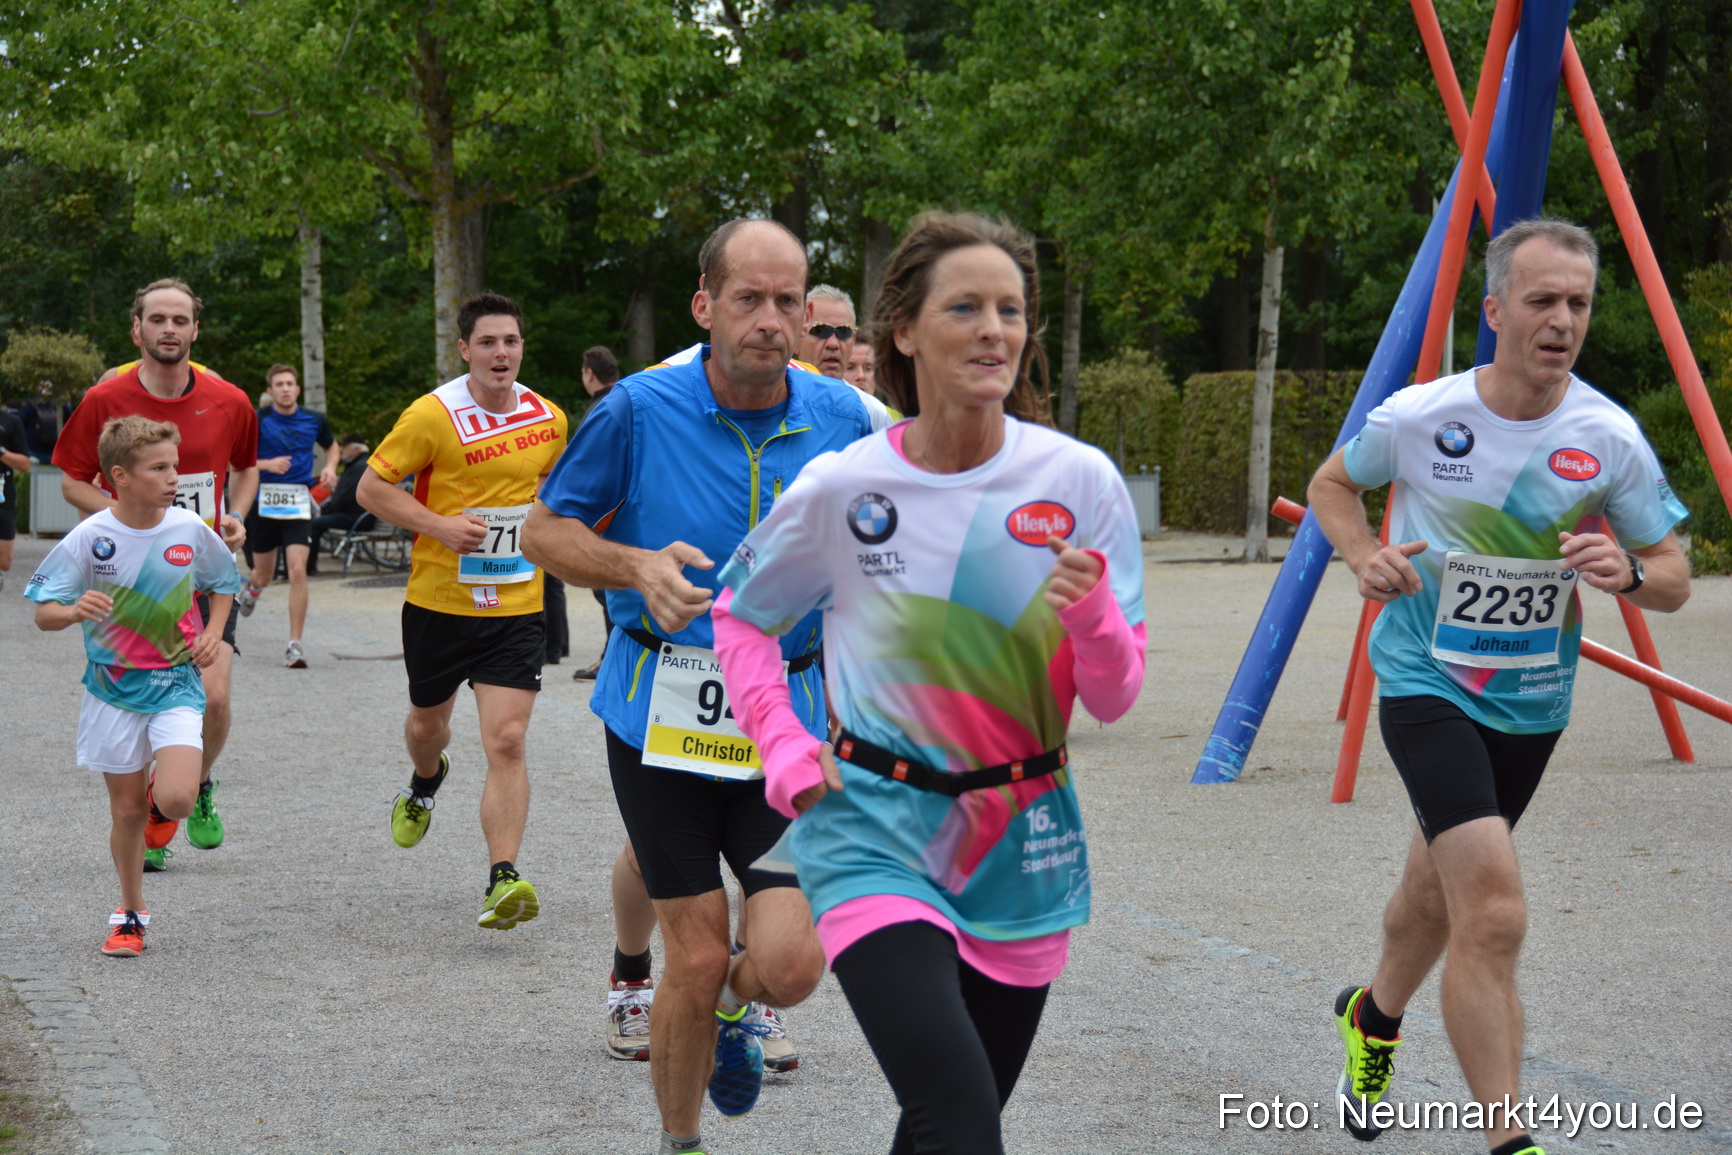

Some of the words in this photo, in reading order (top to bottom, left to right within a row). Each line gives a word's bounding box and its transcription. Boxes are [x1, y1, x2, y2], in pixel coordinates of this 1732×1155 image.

[465, 442, 512, 466] MAX
[514, 427, 560, 451] BÖGL
[1432, 462, 1474, 475] PARTL
[1555, 454, 1596, 473] Hervis
[1432, 472, 1473, 483] Neumarkt
[263, 492, 296, 506] 3081
[1016, 513, 1067, 535] Hervis
[169, 550, 193, 561] Hervis
[857, 551, 905, 567] PARTL
[482, 560, 519, 573] Manuel
[1448, 561, 1493, 578] PARTL
[1496, 569, 1556, 580] Neumarkt
[1452, 580, 1559, 626] 2233
[1470, 635, 1530, 653] Johann
[661, 656, 706, 671] PARTL
[1520, 667, 1573, 682] Neumarkter
[1518, 680, 1563, 695] Stadtlauf
[654, 714, 660, 723] B
[682, 736, 753, 763] Christof
[1025, 805, 1057, 835] 16.
